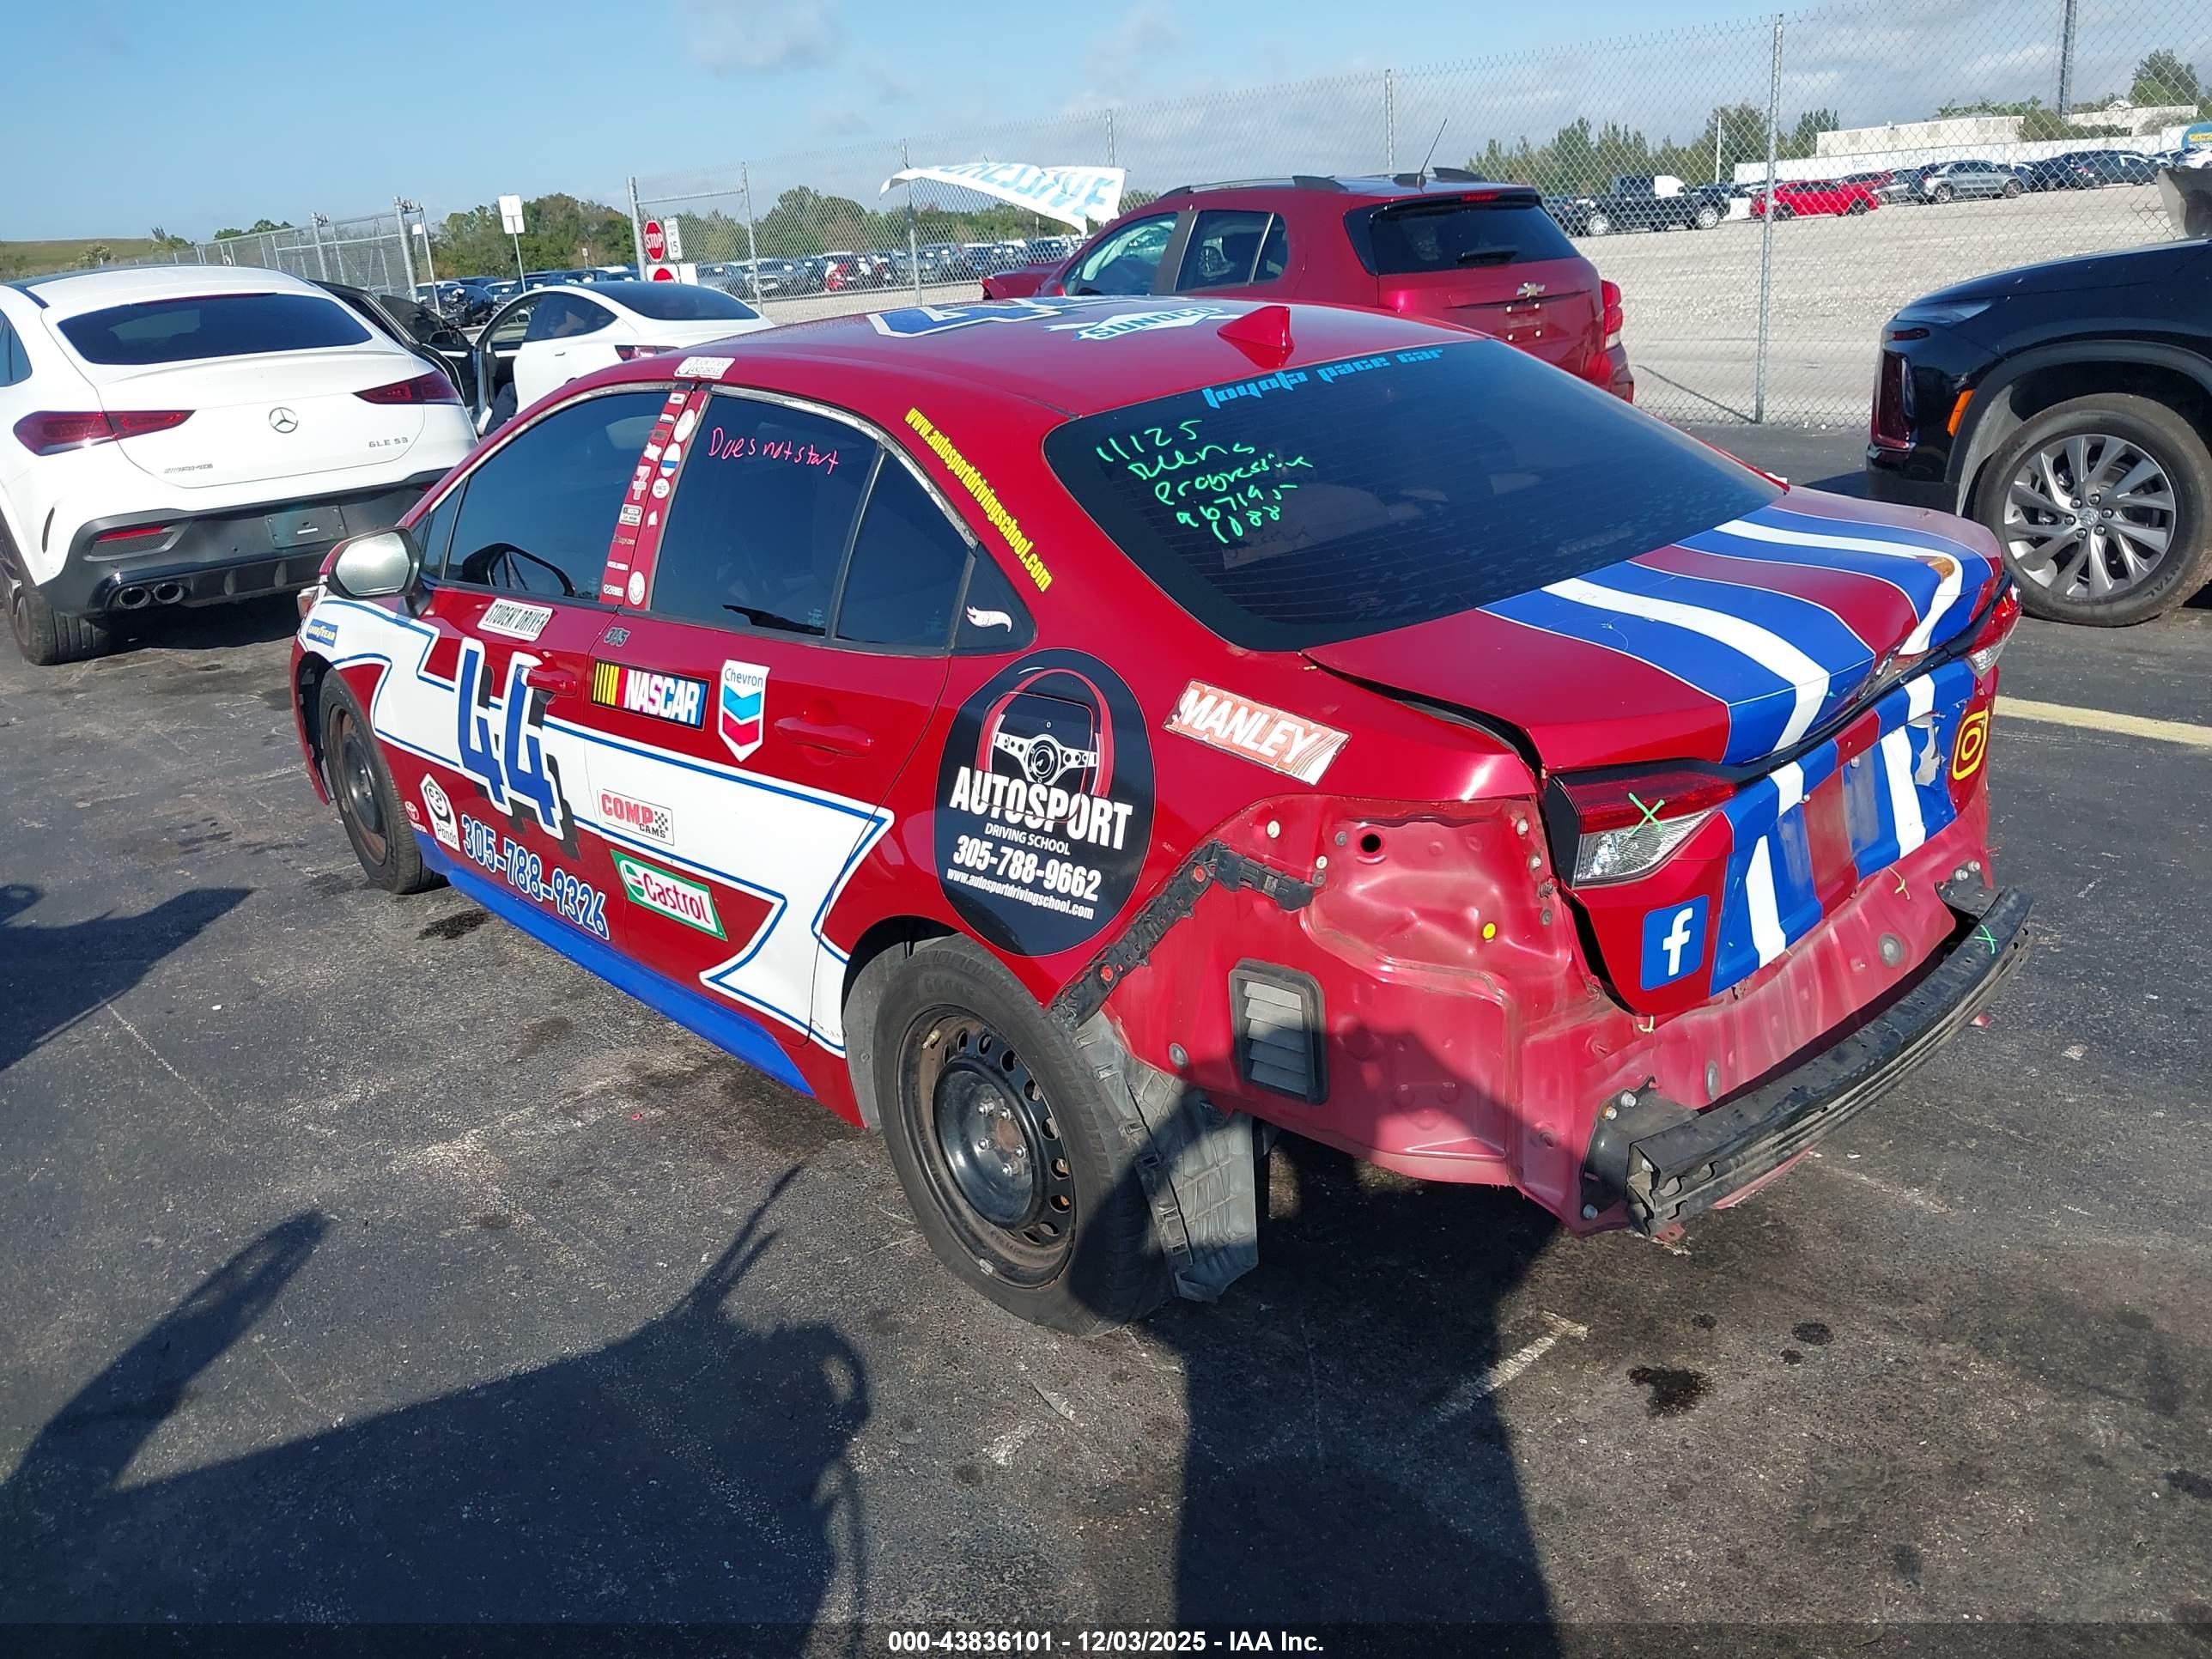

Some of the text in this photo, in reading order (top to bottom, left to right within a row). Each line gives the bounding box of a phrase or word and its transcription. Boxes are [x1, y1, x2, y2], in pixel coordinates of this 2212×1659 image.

[646, 233, 663, 249] STOP
[670, 241, 678, 253] 15
[1085, 307, 1214, 337] SUNOCO
[368, 436, 409, 448] GLE 53
[708, 427, 839, 475] Does not start
[904, 407, 1053, 592] www.autosportdrivingschool.com
[485, 604, 550, 633] STUDENT DRIVER
[623, 669, 701, 726] NASCAR
[724, 667, 763, 687] Chevron
[456, 637, 564, 840] 44
[1179, 689, 1322, 764] MANLEY
[601, 793, 654, 825] COMP
[639, 823, 666, 839] CAMS
[949, 766, 1133, 850] AUTOSPORT
[984, 823, 1071, 856] DRIVING SCHOOL
[461, 811, 610, 941] 305-788-9326
[952, 835, 1103, 902] 305-788-9662
[643, 872, 712, 924] Castrol
[946, 868, 1095, 921] www.autosportdrivingschool.com
